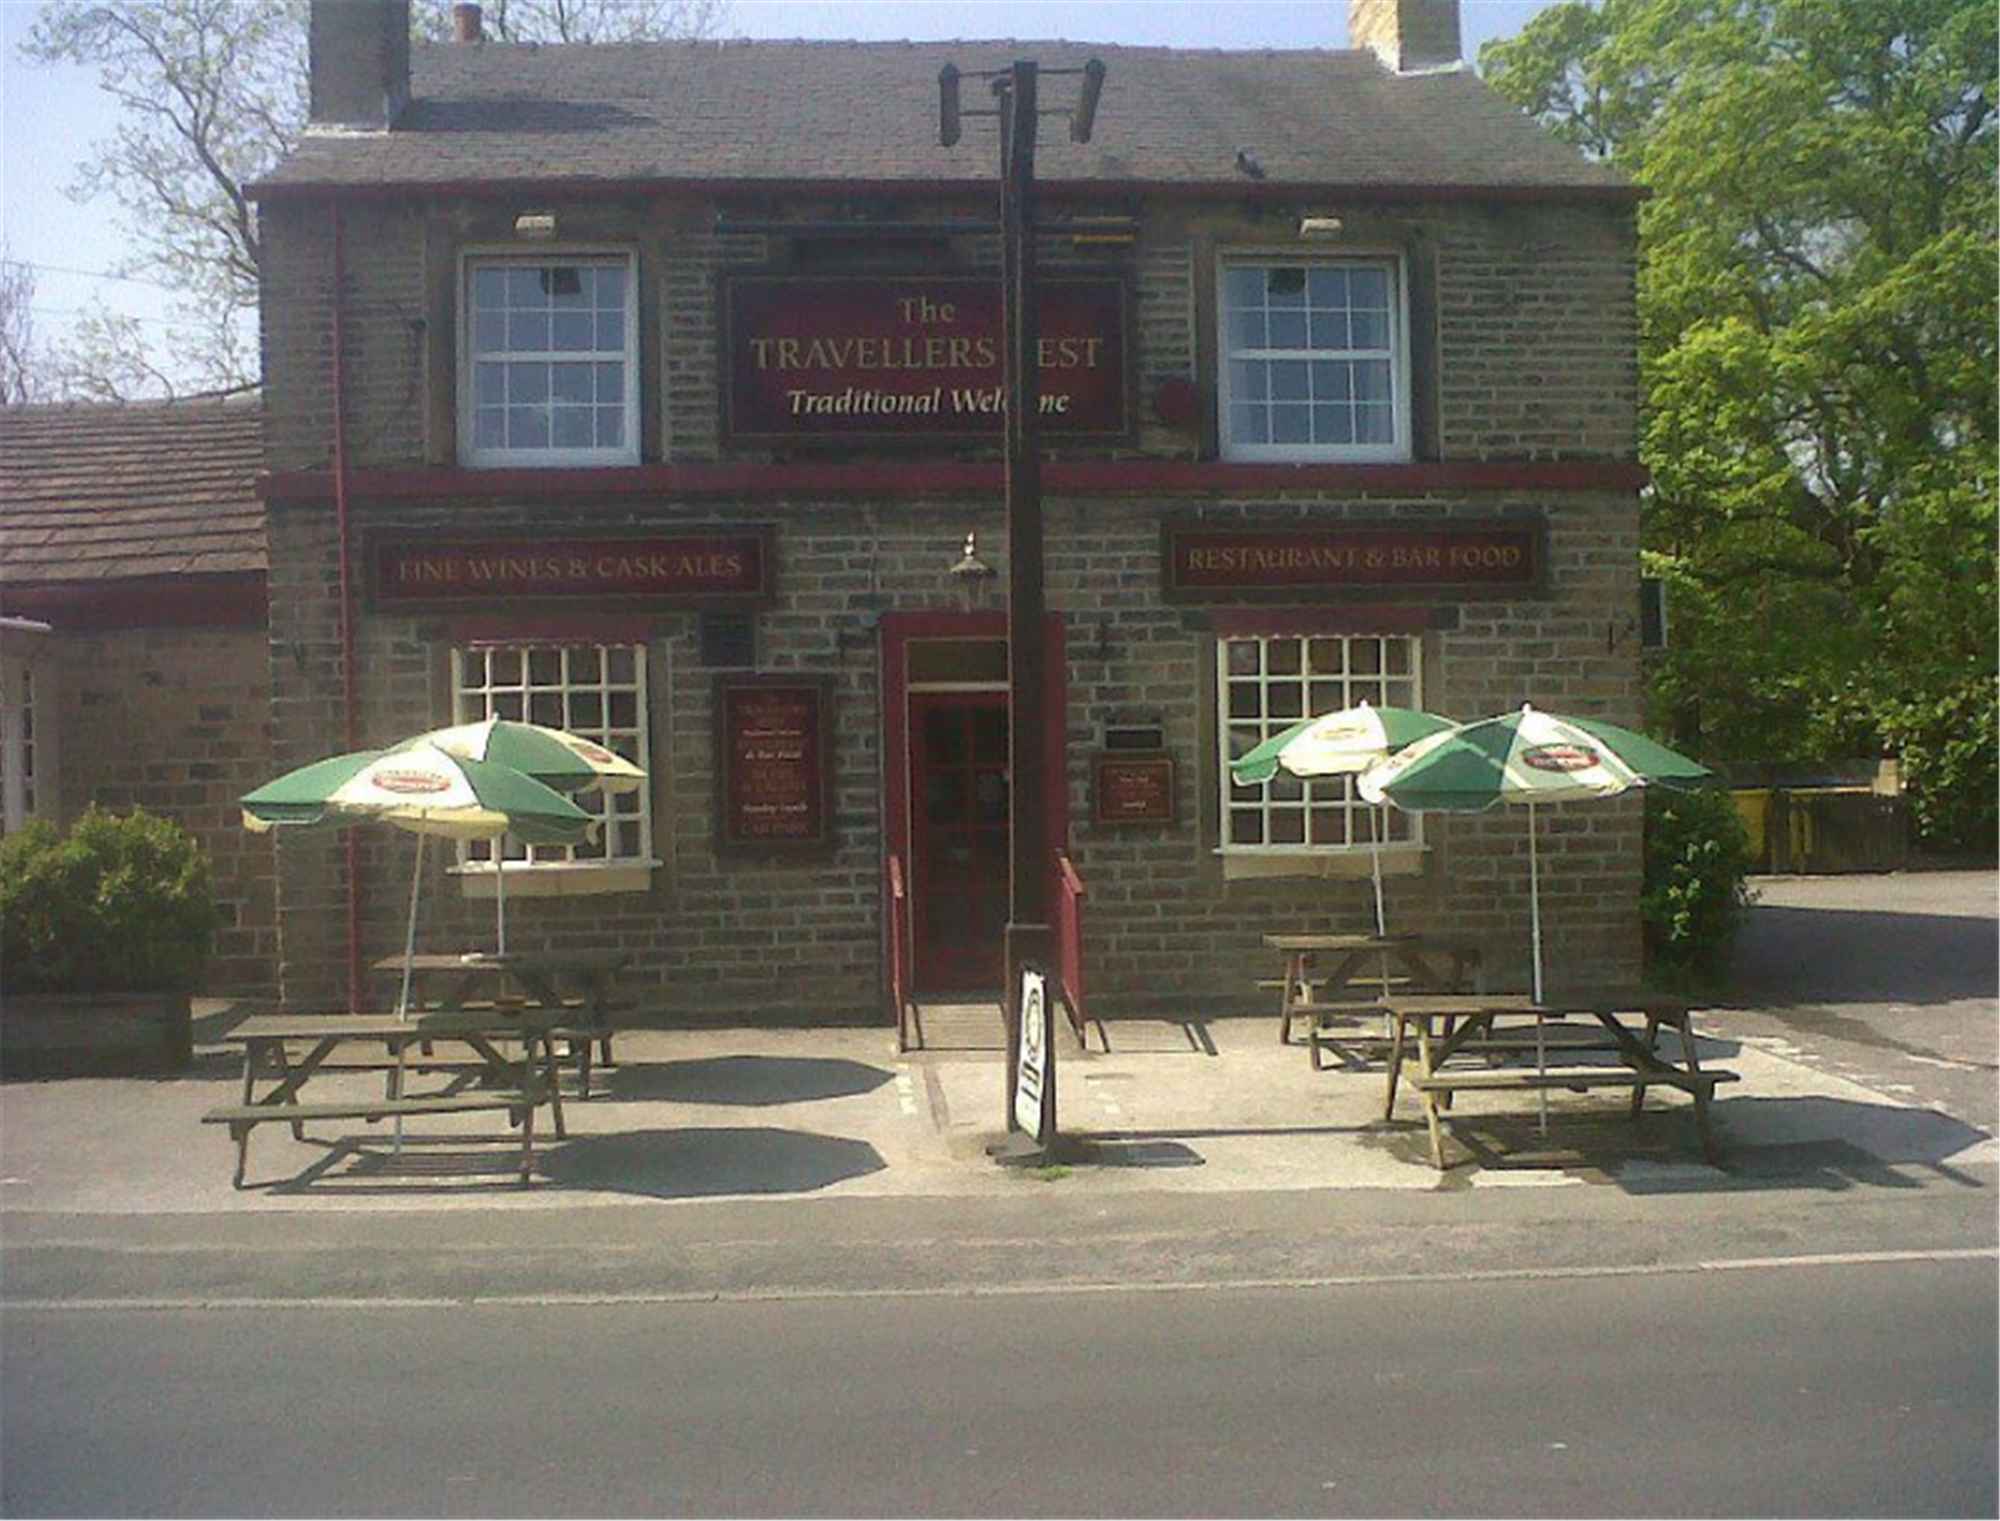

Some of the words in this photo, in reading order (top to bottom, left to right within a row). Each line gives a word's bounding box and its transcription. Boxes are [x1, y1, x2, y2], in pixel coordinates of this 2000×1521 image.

[900, 296, 955, 325] The
[751, 337, 996, 369] TRAVELLERS
[1037, 337, 1102, 369] EST
[787, 387, 942, 414] Traditional
[399, 559, 461, 582] FINE
[467, 558, 560, 581] WINES
[568, 558, 588, 578] &
[596, 556, 669, 579] CASK
[675, 553, 742, 577] ALES
[1187, 546, 1357, 570] RESTAURANT
[1365, 547, 1384, 567] &
[1393, 547, 1441, 568] BAR
[1450, 546, 1521, 567] FOOD
